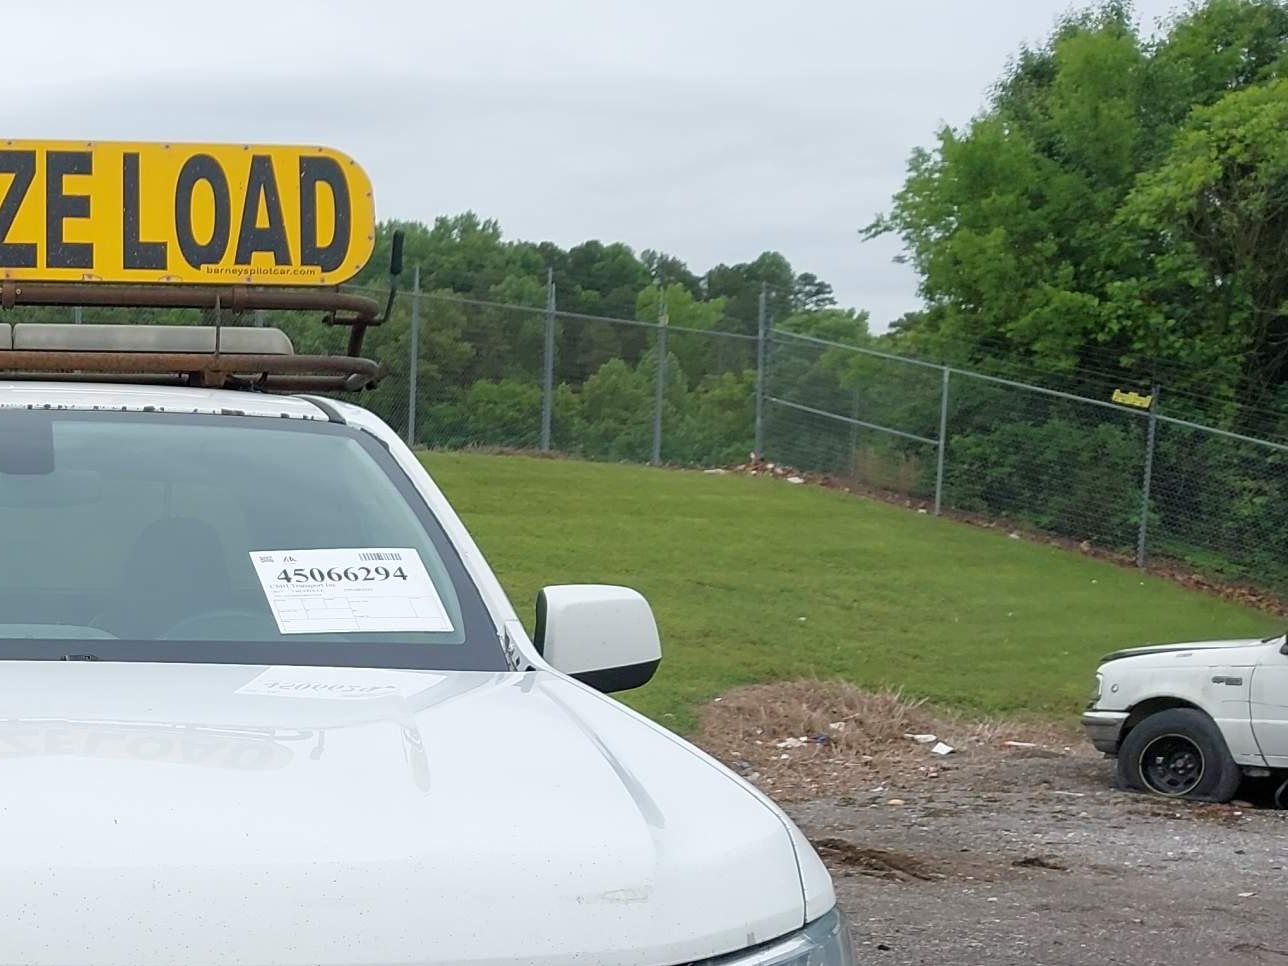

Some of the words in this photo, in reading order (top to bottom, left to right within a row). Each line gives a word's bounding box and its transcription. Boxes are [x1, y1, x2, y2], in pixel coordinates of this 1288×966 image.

[122, 151, 352, 271] LOAD
[205, 265, 317, 277] barneyspilotcar.com
[276, 565, 408, 584] 45066294
